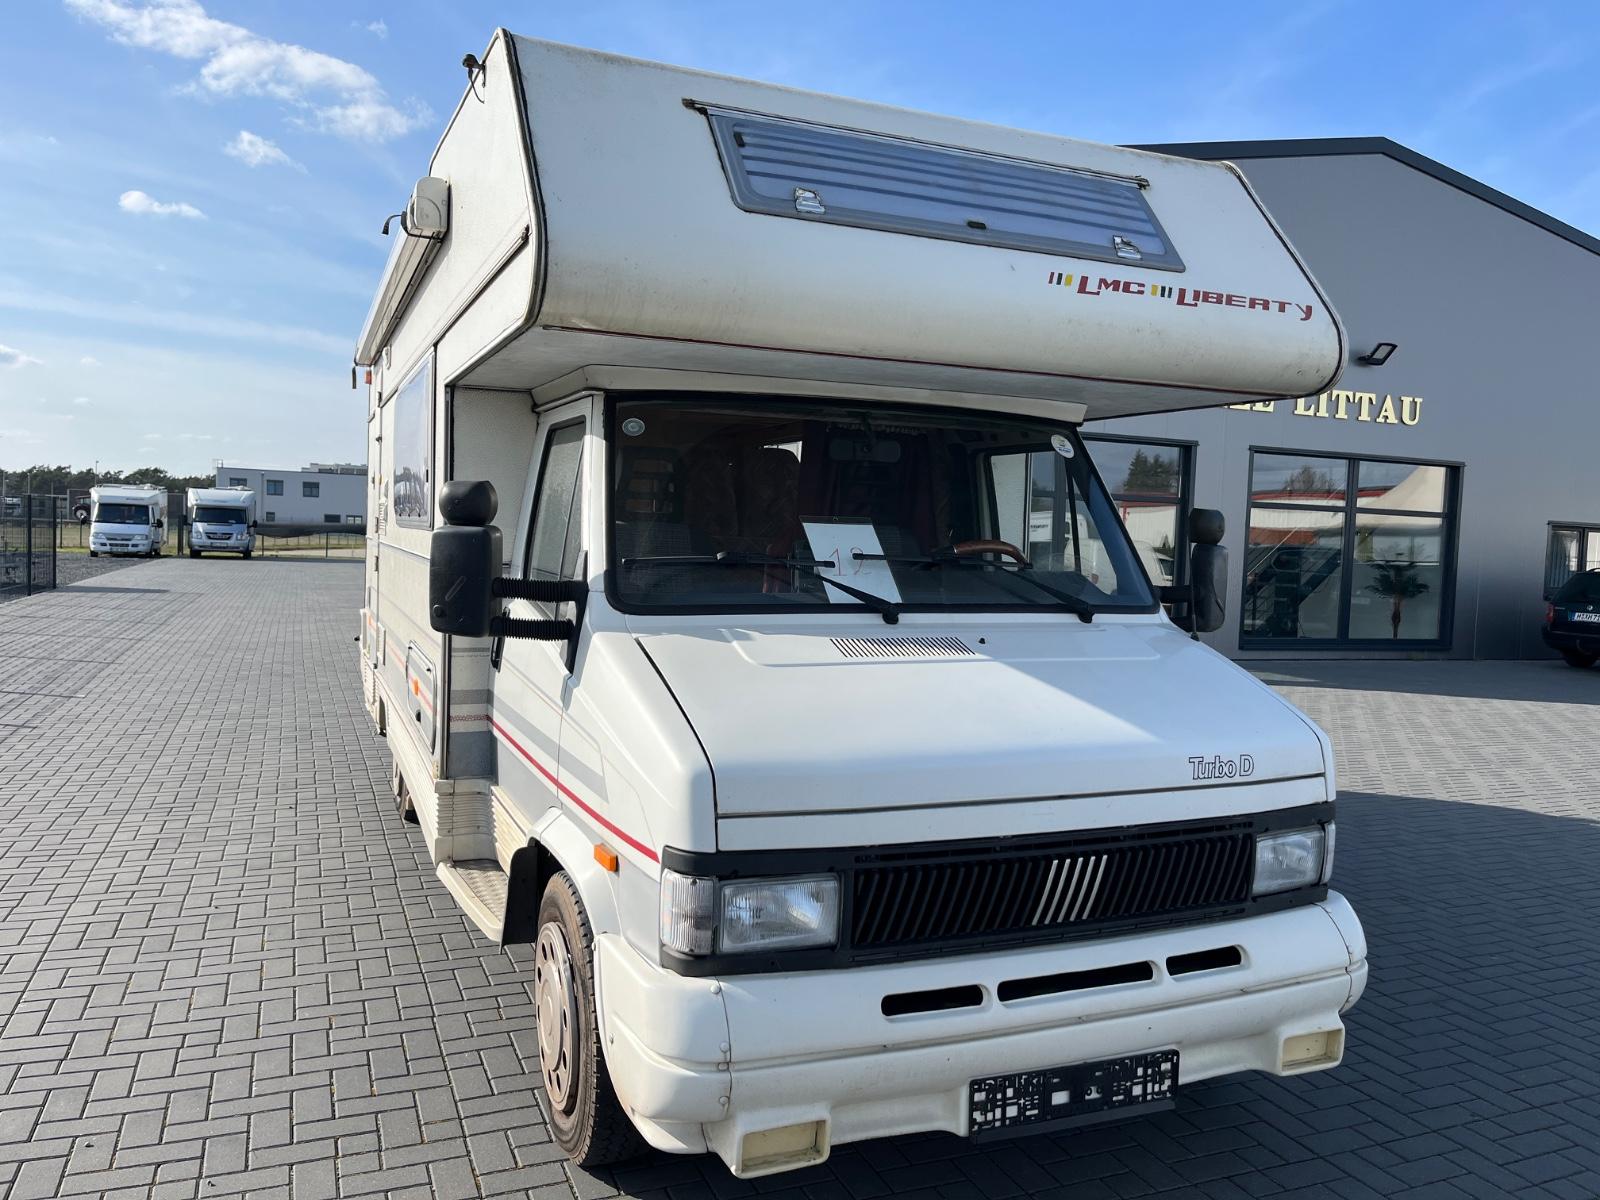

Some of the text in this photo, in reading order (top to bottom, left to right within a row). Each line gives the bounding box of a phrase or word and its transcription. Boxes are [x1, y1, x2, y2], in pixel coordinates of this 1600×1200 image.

[1077, 275, 1313, 321] LMC LIBERTY
[1294, 389, 1423, 426] LITTAU
[1188, 754, 1255, 780] Turbo D
